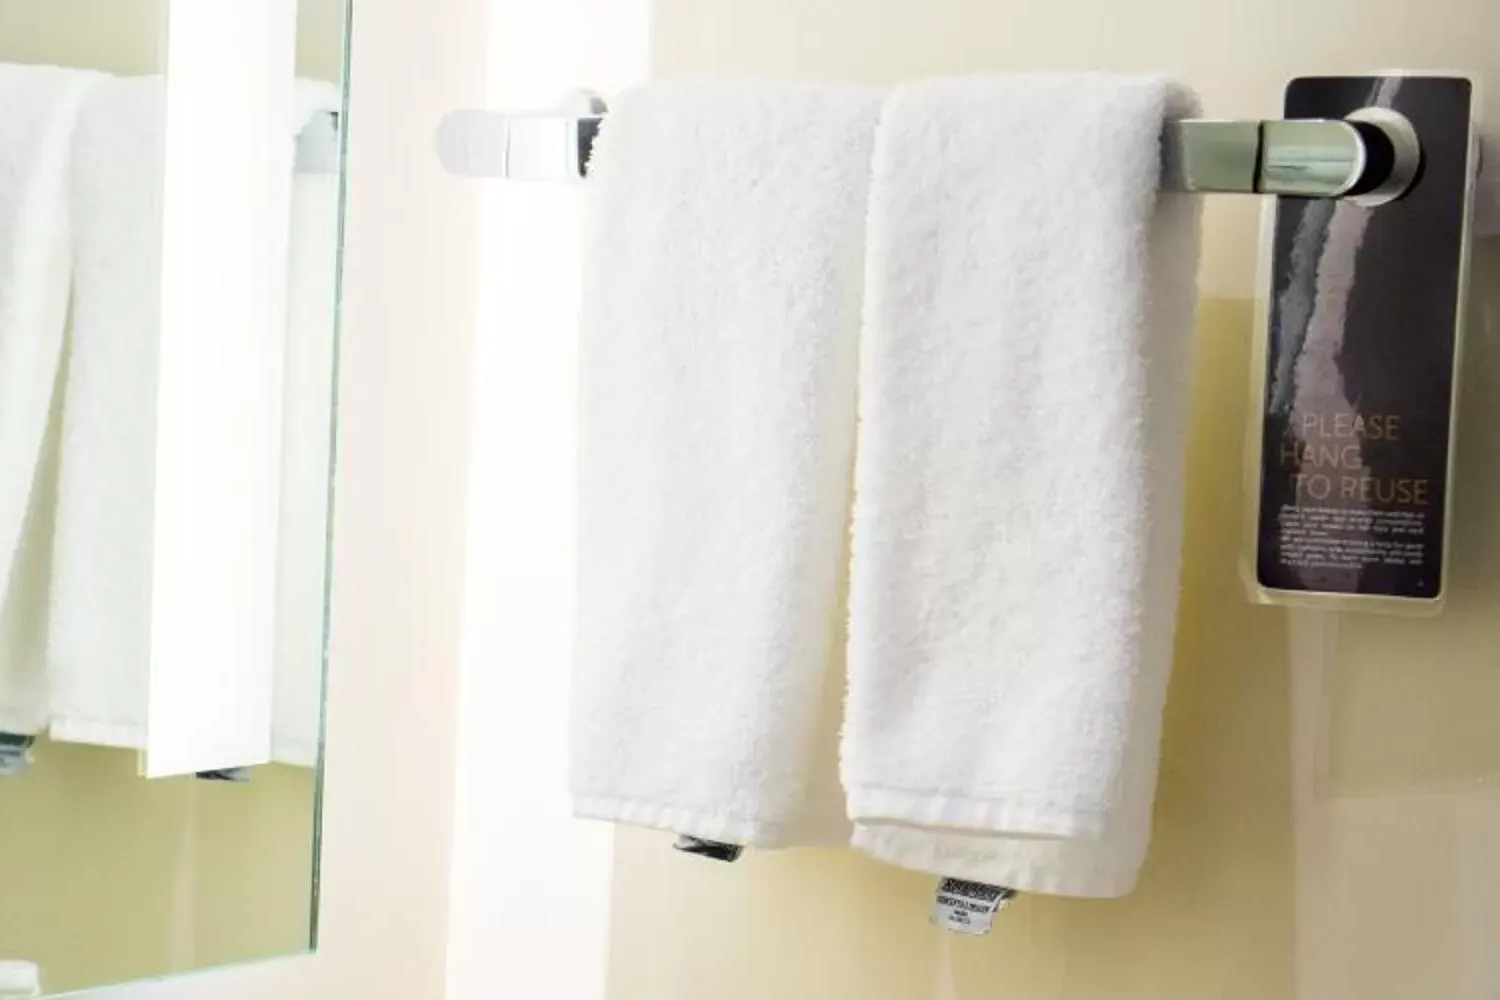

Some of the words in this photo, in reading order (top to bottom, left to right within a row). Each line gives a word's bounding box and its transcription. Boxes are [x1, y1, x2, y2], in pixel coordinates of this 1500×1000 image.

[1302, 413, 1400, 440] PLEASE
[1280, 443, 1363, 469] HANG
[1291, 474, 1331, 499] TO
[1342, 477, 1429, 504] REUSE
